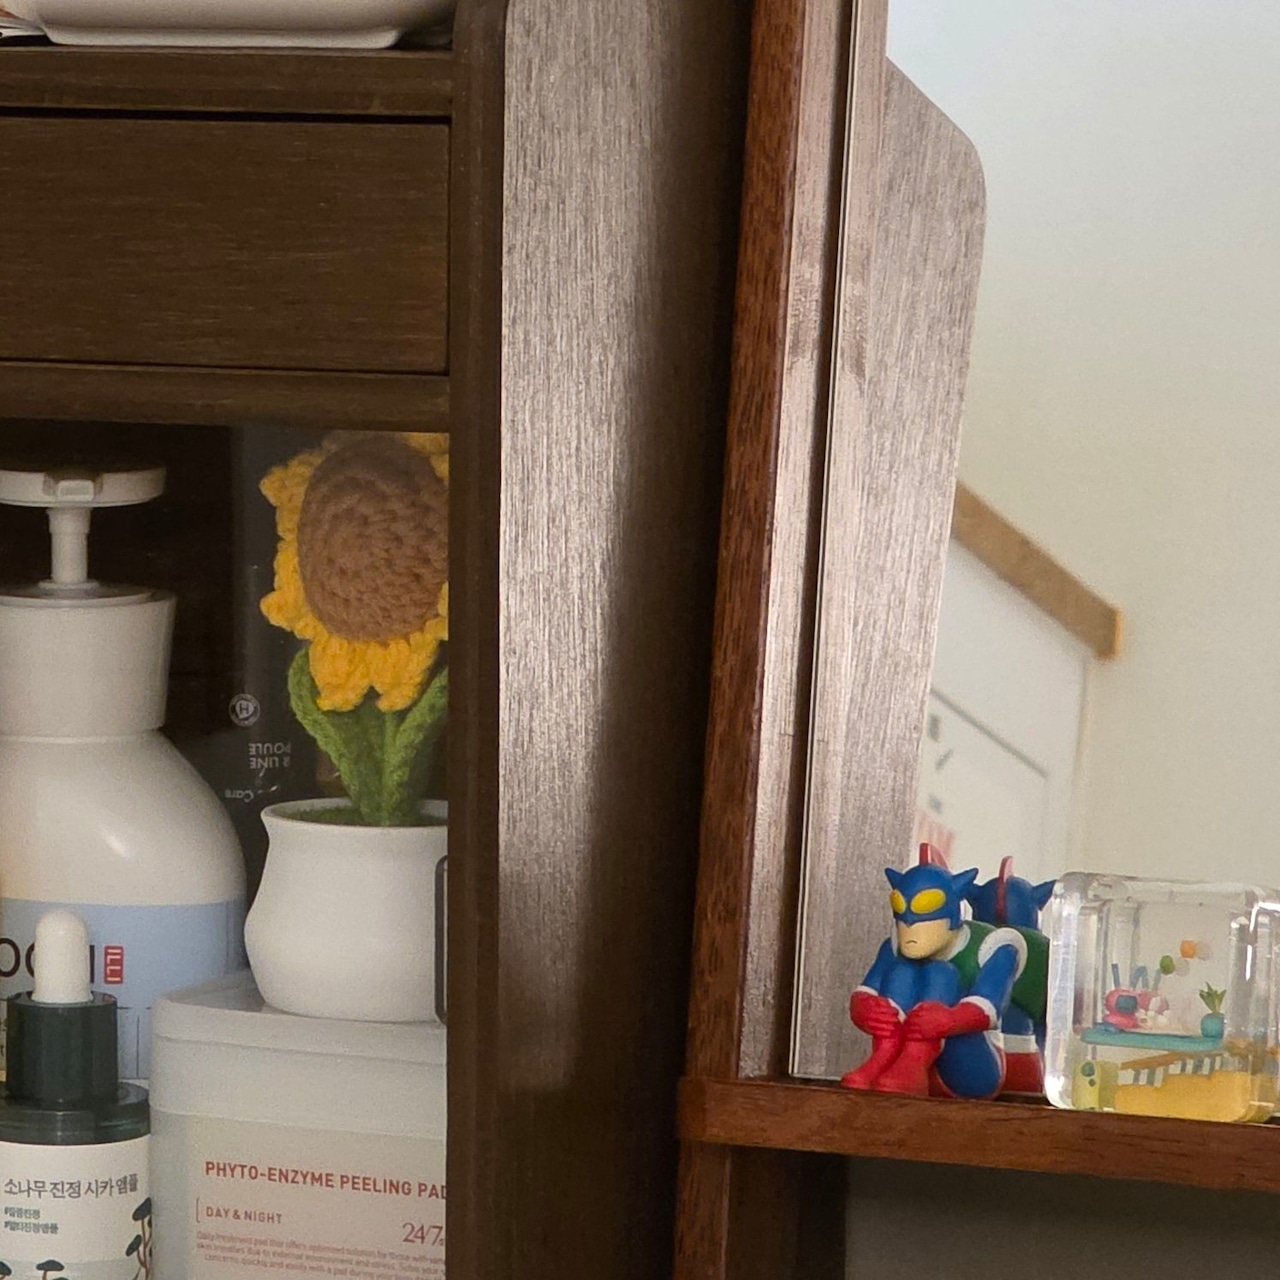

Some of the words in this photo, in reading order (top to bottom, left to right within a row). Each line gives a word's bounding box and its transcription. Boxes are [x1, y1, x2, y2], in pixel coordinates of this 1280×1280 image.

[106, 948, 122, 982] ILLI
[3, 1178, 48, 1199] 소나무
[84, 1178, 114, 1199] 시카
[205, 1161, 335, 1189] PHYTO-ENZYME
[340, 1174, 412, 1196] PEELING
[206, 1205, 231, 1219] DAY
[232, 1208, 241, 1221] &
[243, 1209, 283, 1224] NIGHT
